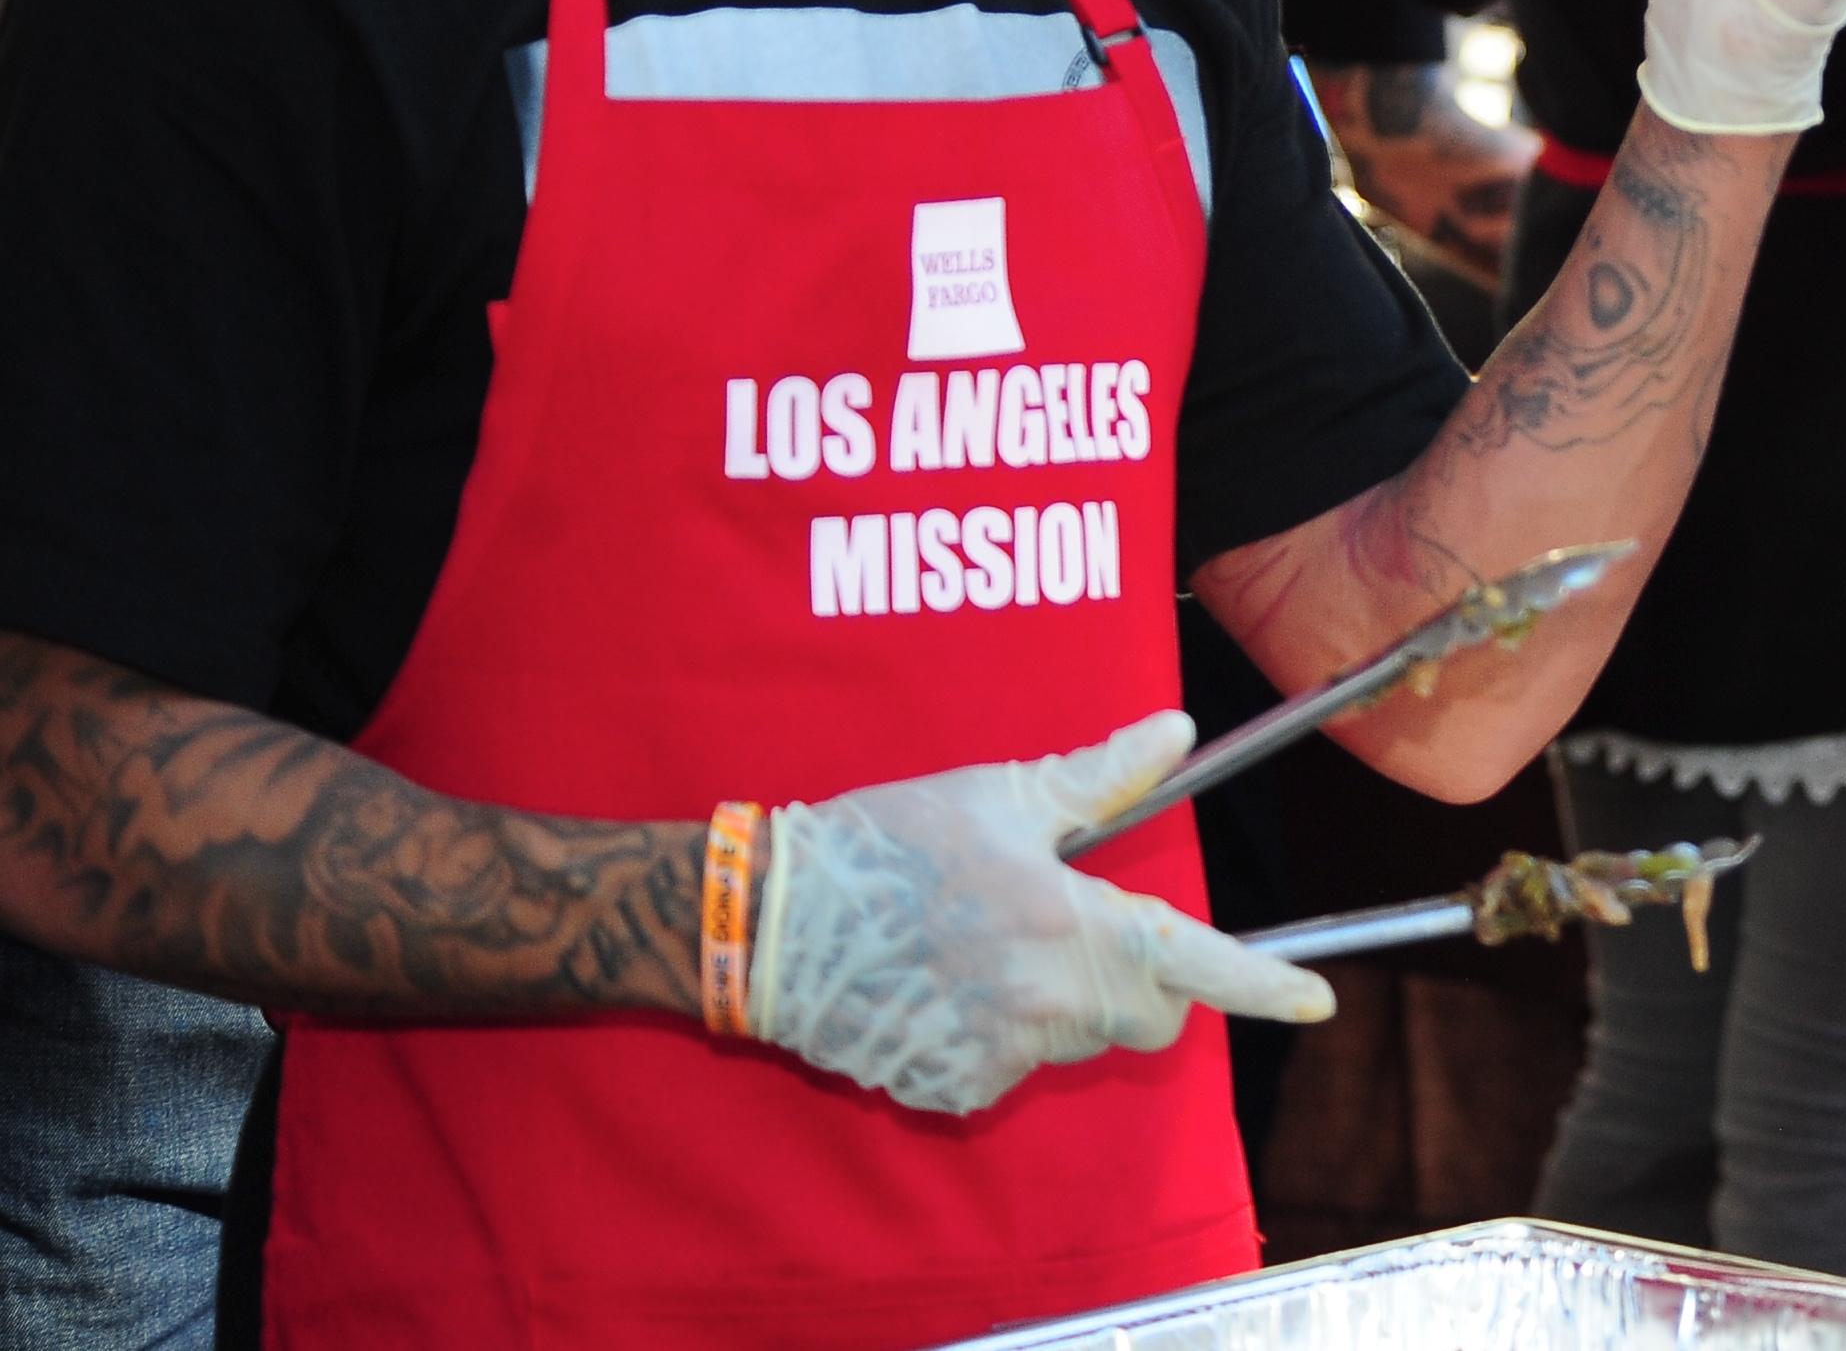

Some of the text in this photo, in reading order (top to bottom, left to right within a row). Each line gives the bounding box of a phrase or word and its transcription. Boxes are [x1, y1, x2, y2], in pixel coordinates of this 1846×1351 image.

[919, 248, 995, 274] WELLS
[927, 281, 997, 308] FARGO
[725, 359, 1151, 480] LOS ANGELES
[811, 500, 1120, 617] MISSION
